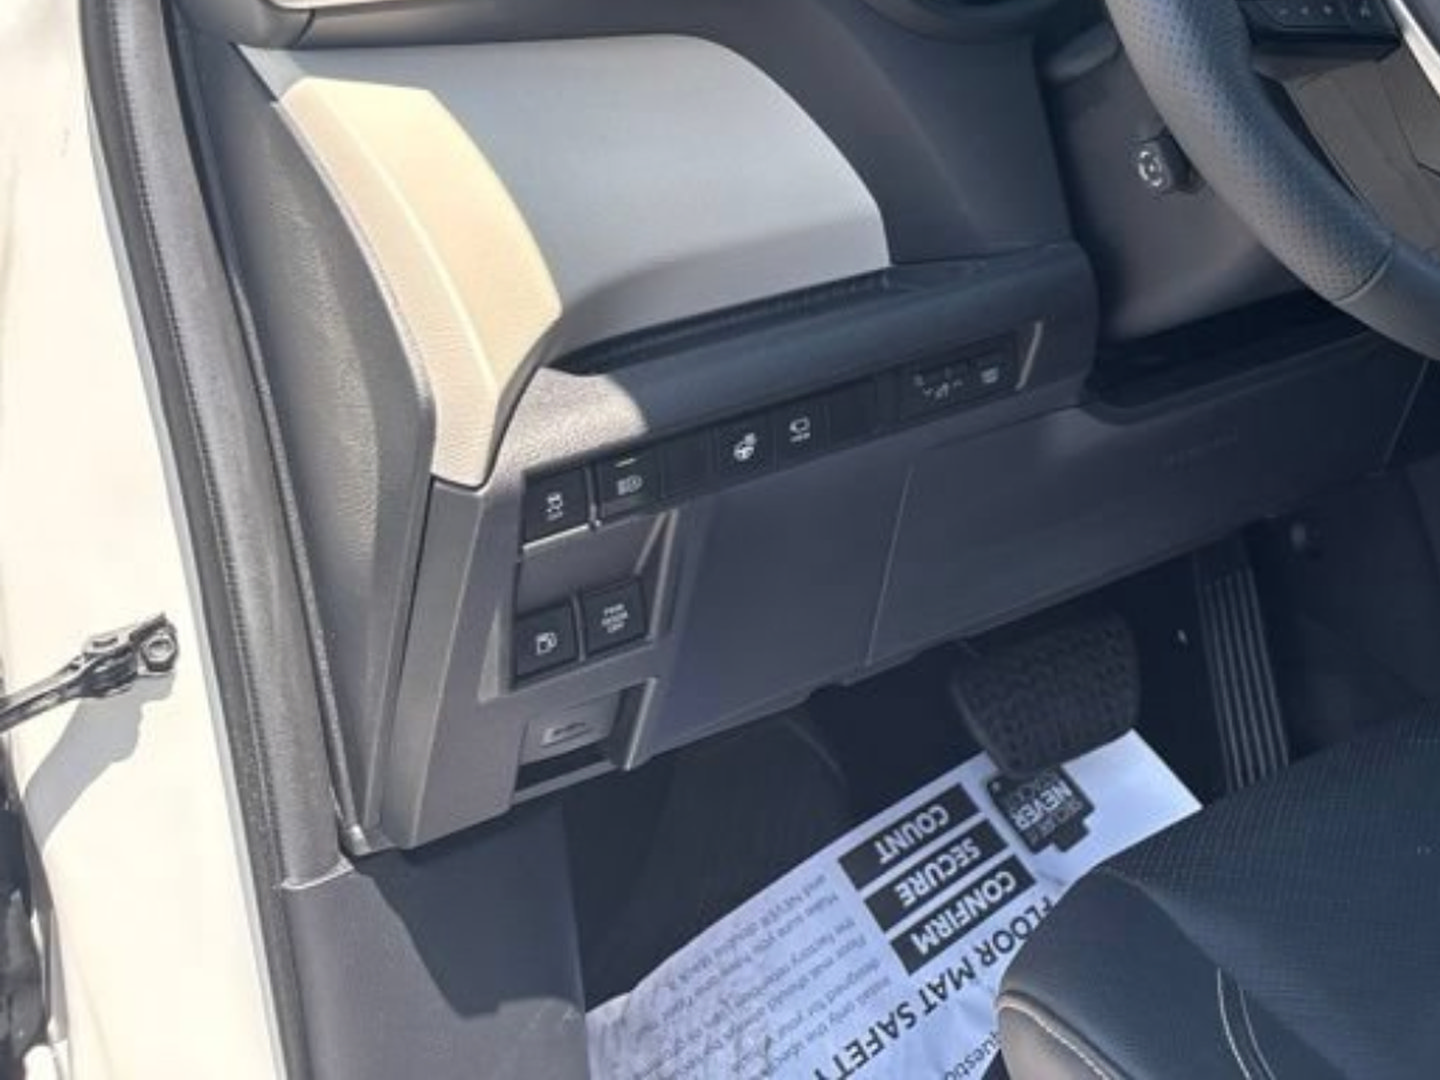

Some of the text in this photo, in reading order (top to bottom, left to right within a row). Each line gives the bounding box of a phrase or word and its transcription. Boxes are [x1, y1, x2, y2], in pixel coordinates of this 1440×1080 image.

[874, 805, 949, 864] COUNT
[1012, 779, 1073, 831] NEVER
[894, 837, 981, 907] SECURE
[910, 871, 1016, 955] CONFIRM
[918, 956, 976, 1016] MAT
